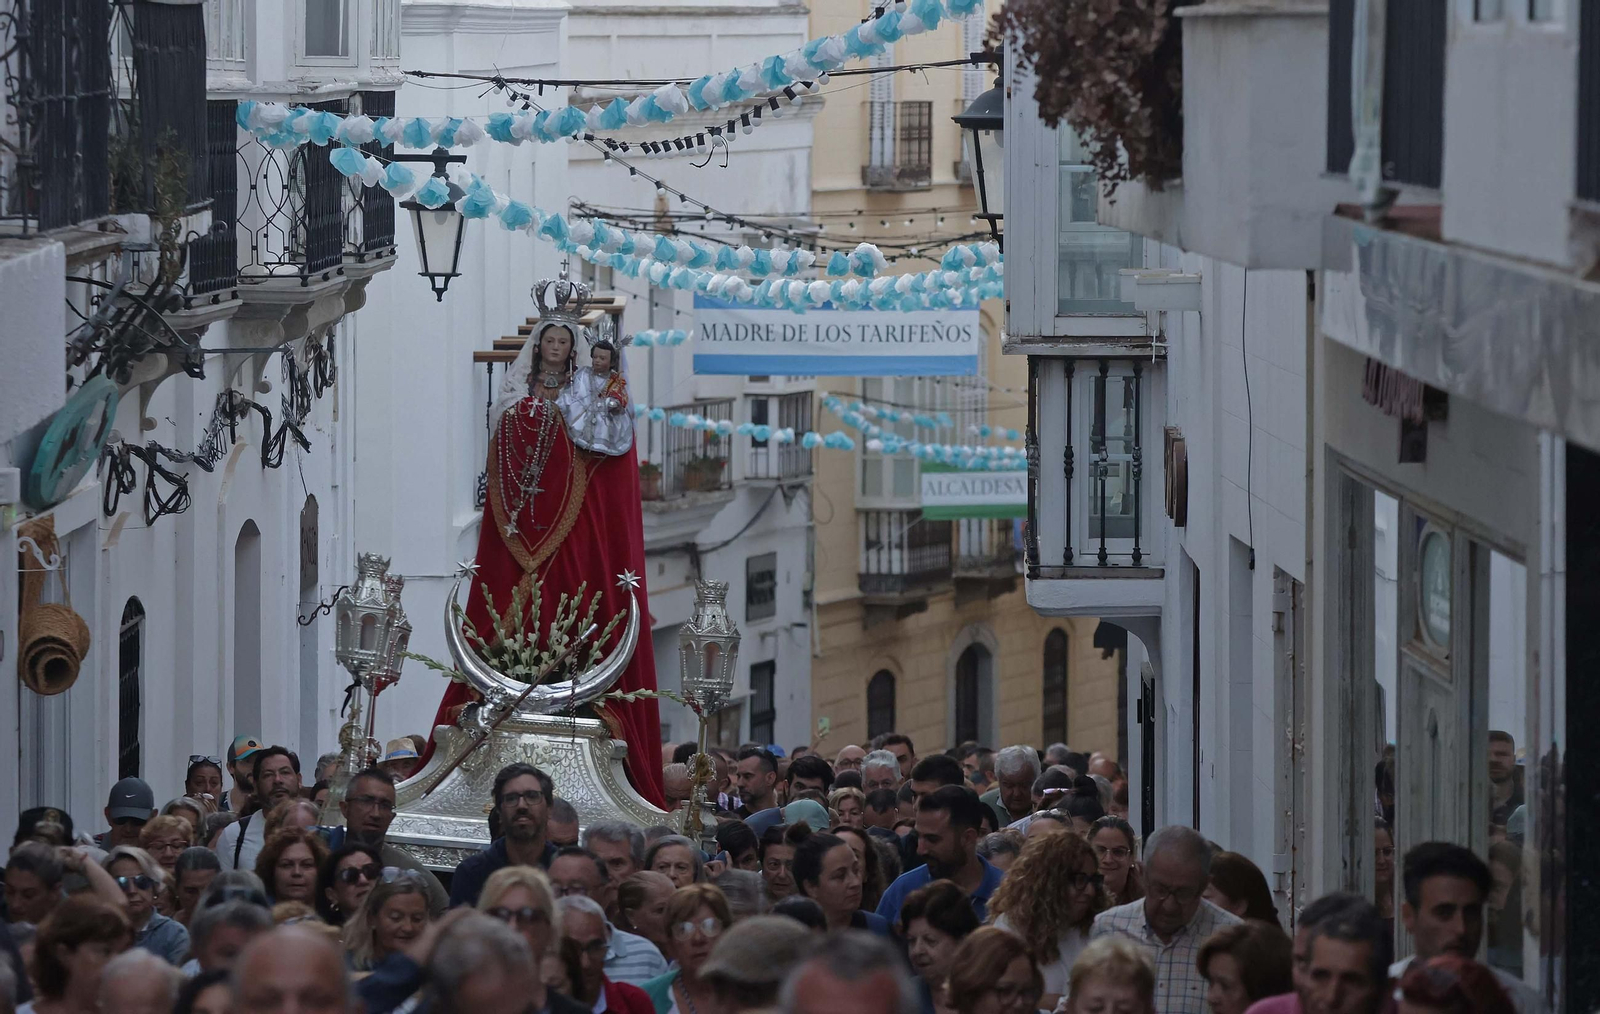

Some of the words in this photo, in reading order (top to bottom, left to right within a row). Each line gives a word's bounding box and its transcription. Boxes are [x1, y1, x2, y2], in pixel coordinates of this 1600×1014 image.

[701, 323, 776, 343] MADRE
[782, 323, 808, 343] DE
[815, 324, 852, 343] LOS
[858, 320, 972, 343] TARIFEÑOS
[925, 480, 1025, 496] ALCALDESA
